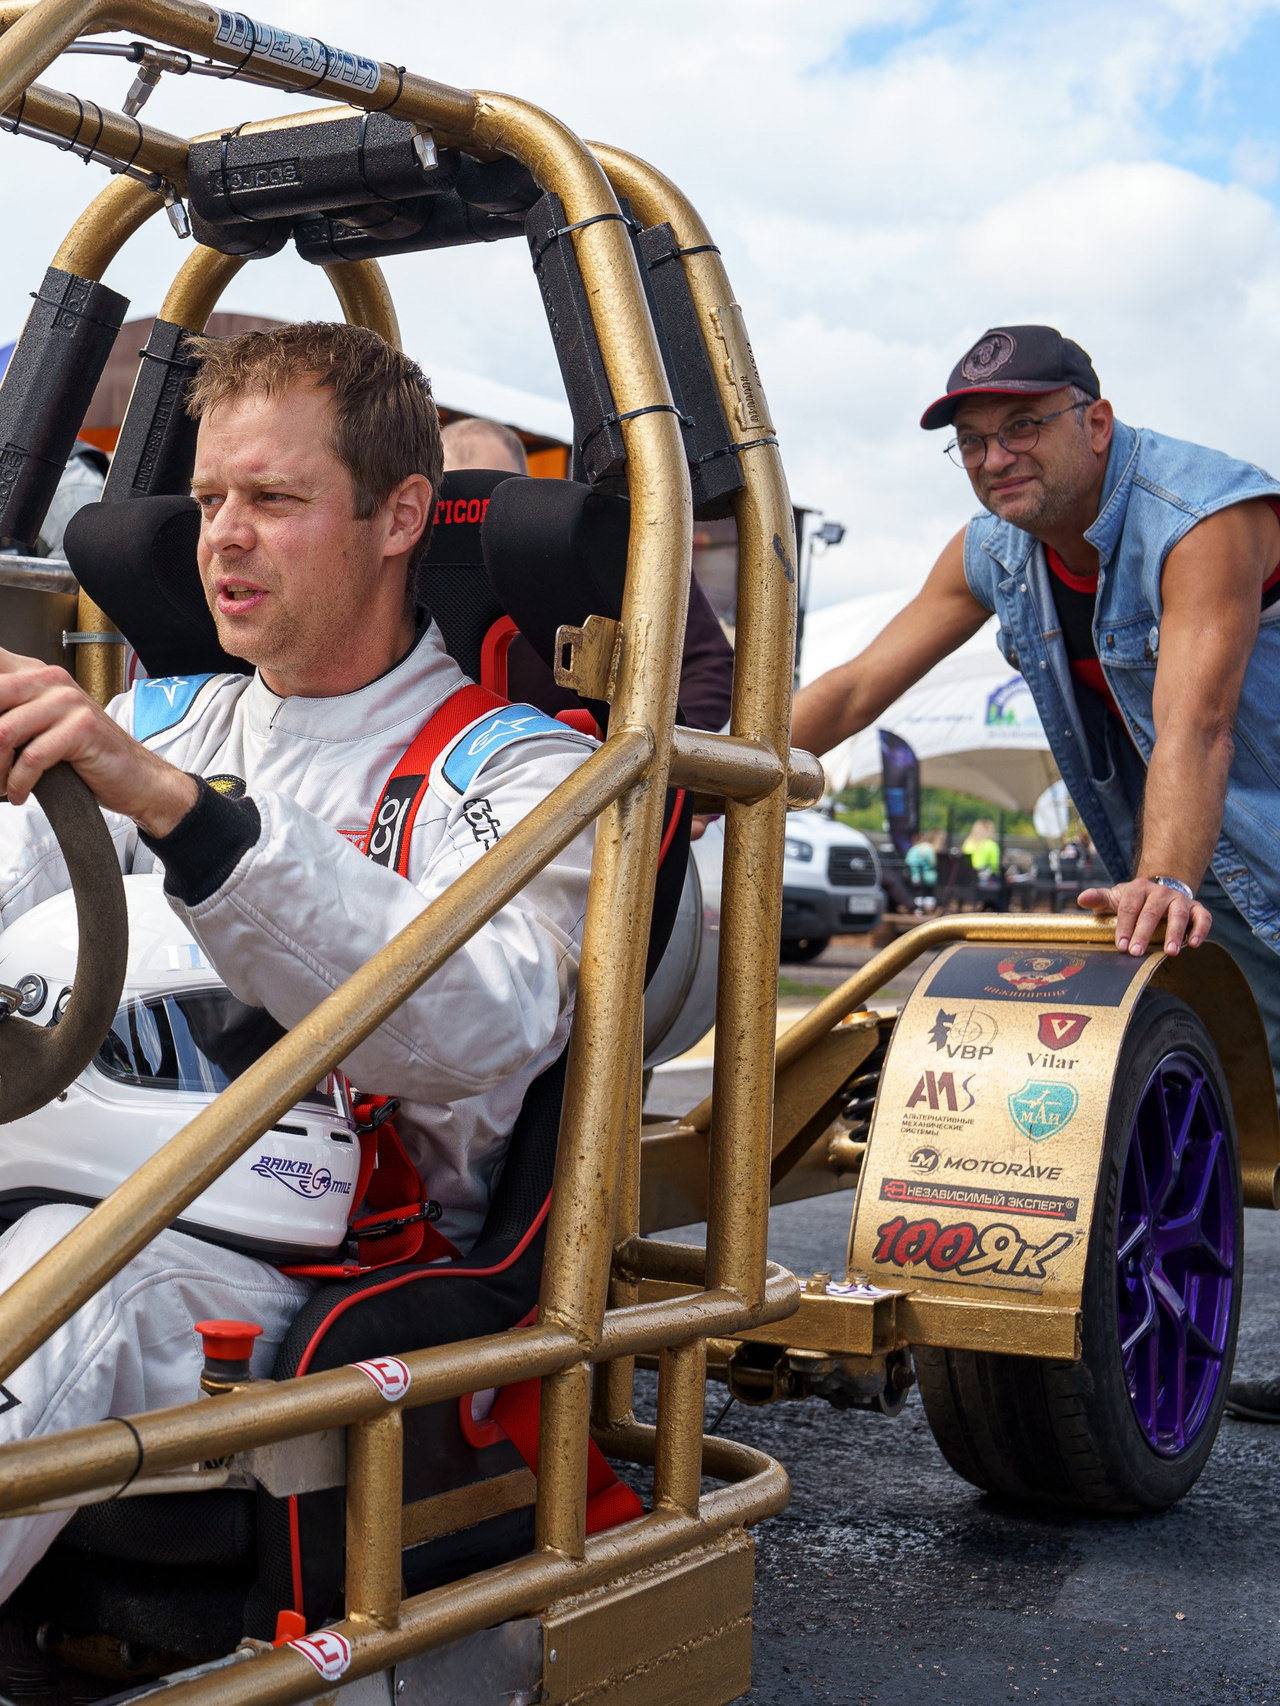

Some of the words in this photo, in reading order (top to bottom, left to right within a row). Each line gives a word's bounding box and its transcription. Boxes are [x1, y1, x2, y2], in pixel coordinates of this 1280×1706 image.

[946, 1044, 994, 1060] VBP
[1026, 1052, 1080, 1070] Vilar
[902, 1120, 964, 1131] МЕХАНИЧЕСКИЕ
[903, 1113, 975, 1125] АЛЬТЕРНАТИВНЫЕ
[900, 1127, 939, 1136] СИСТЕМЫ
[259, 1155, 313, 1175] BAIKAL
[330, 1180, 352, 1194] MILE
[943, 1156, 1063, 1181] MOTORAVE
[906, 1185, 1005, 1206] НЕЗАВИСИМЫЙ
